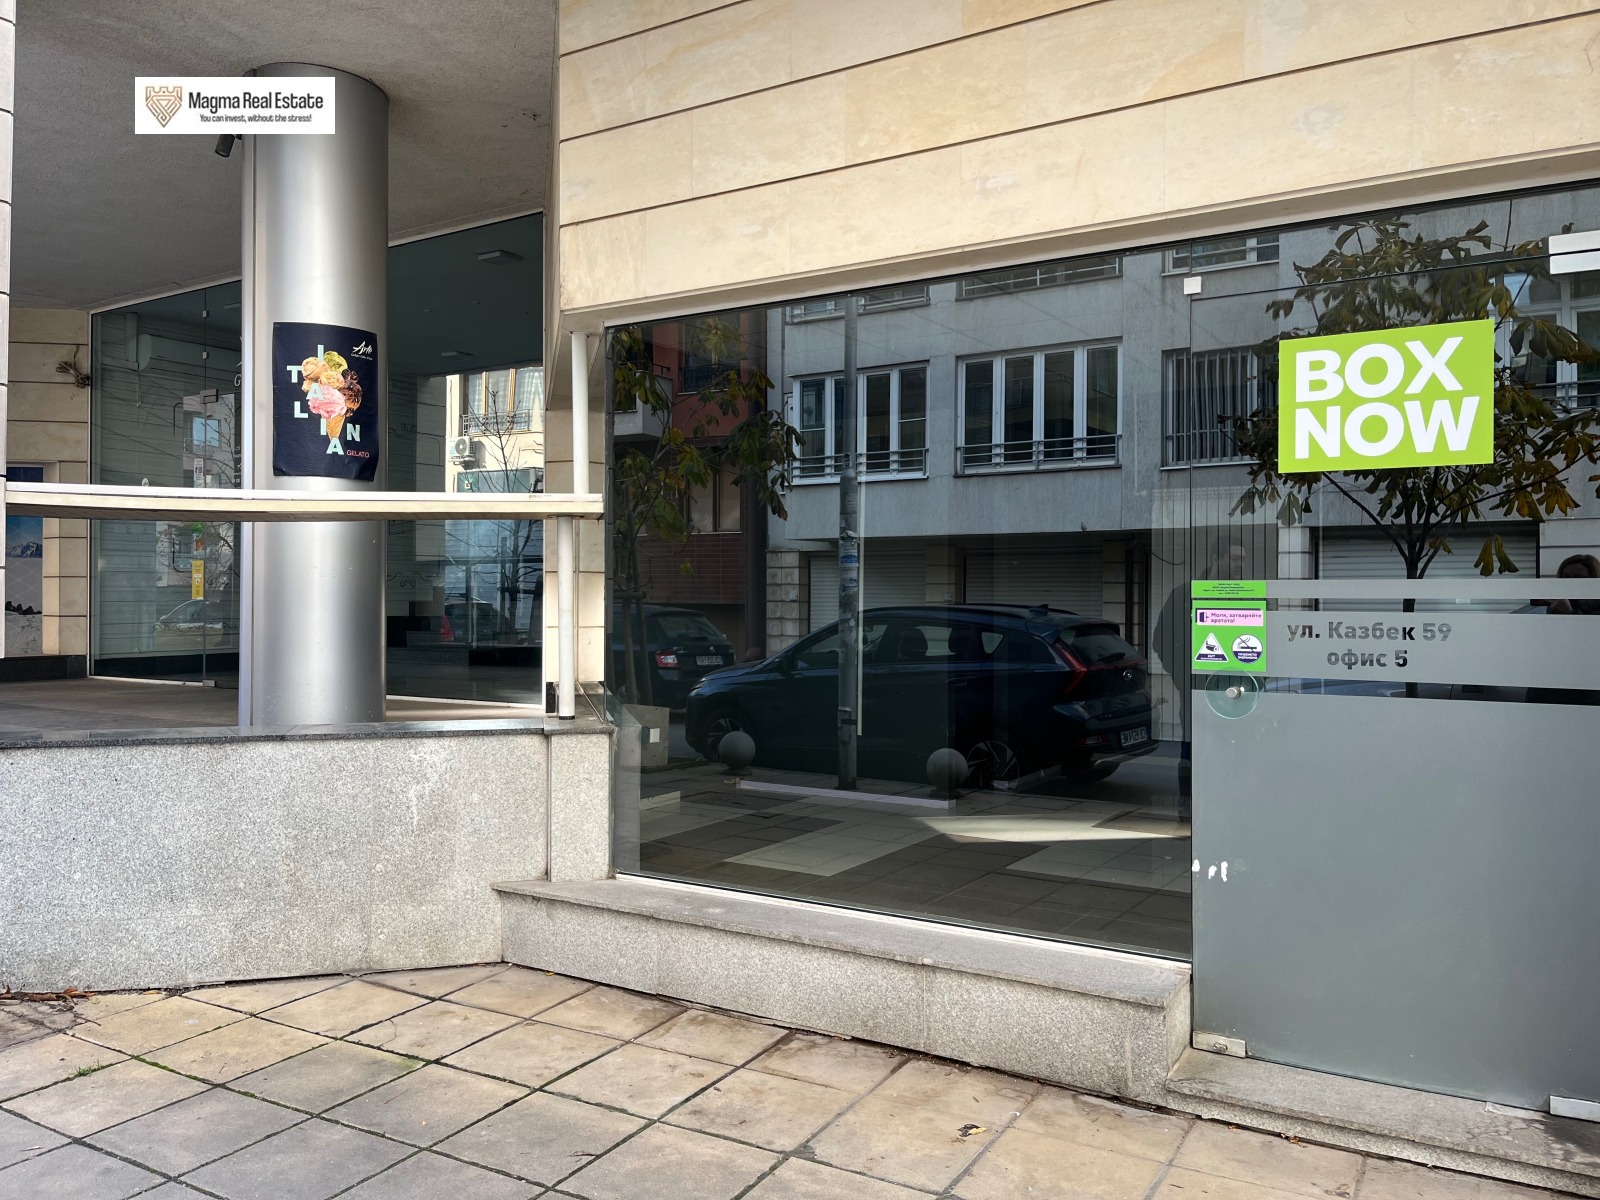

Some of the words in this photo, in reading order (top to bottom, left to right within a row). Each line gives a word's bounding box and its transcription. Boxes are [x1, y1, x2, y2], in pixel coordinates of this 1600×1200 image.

[1295, 336, 1463, 403] BOX
[1295, 396, 1480, 459] NOW
[346, 449, 370, 458] GELATO
[1286, 624, 1321, 642] ул.
[1327, 621, 1416, 641] Казбек
[1422, 622, 1452, 642] 59
[1326, 649, 1388, 670] офис
[1394, 649, 1408, 668] 5
